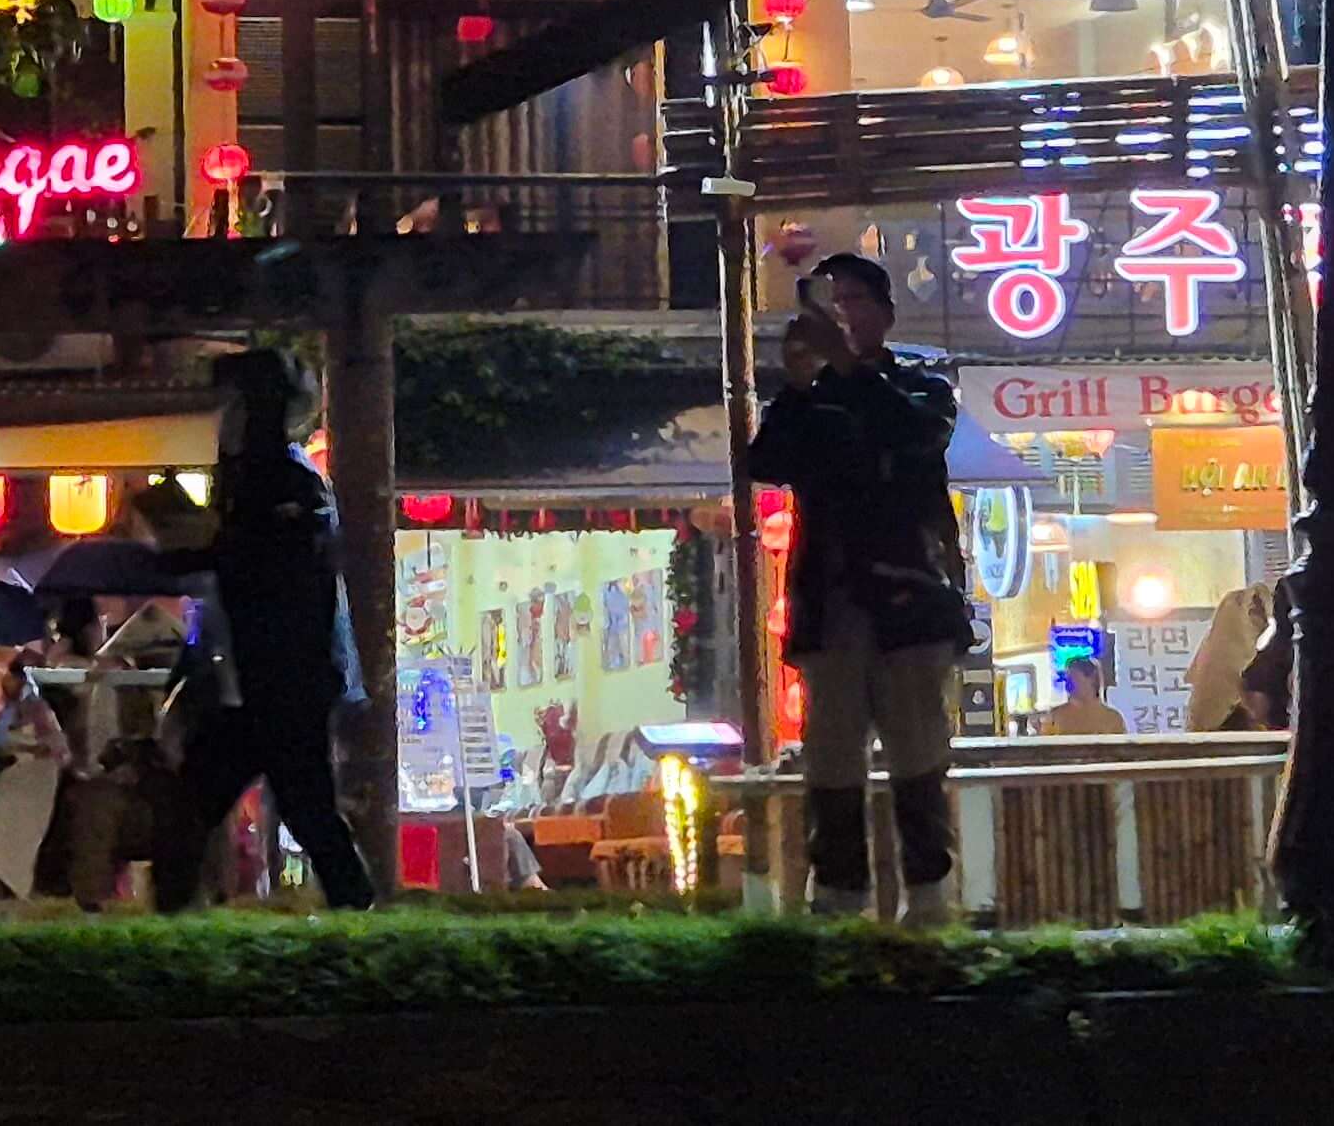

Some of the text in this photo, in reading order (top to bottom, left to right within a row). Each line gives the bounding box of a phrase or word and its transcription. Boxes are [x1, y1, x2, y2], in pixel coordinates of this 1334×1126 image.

[993, 376, 1108, 419] Grill
[1126, 625, 1190, 657] 라면
[1129, 664, 1193, 696] 먹고
